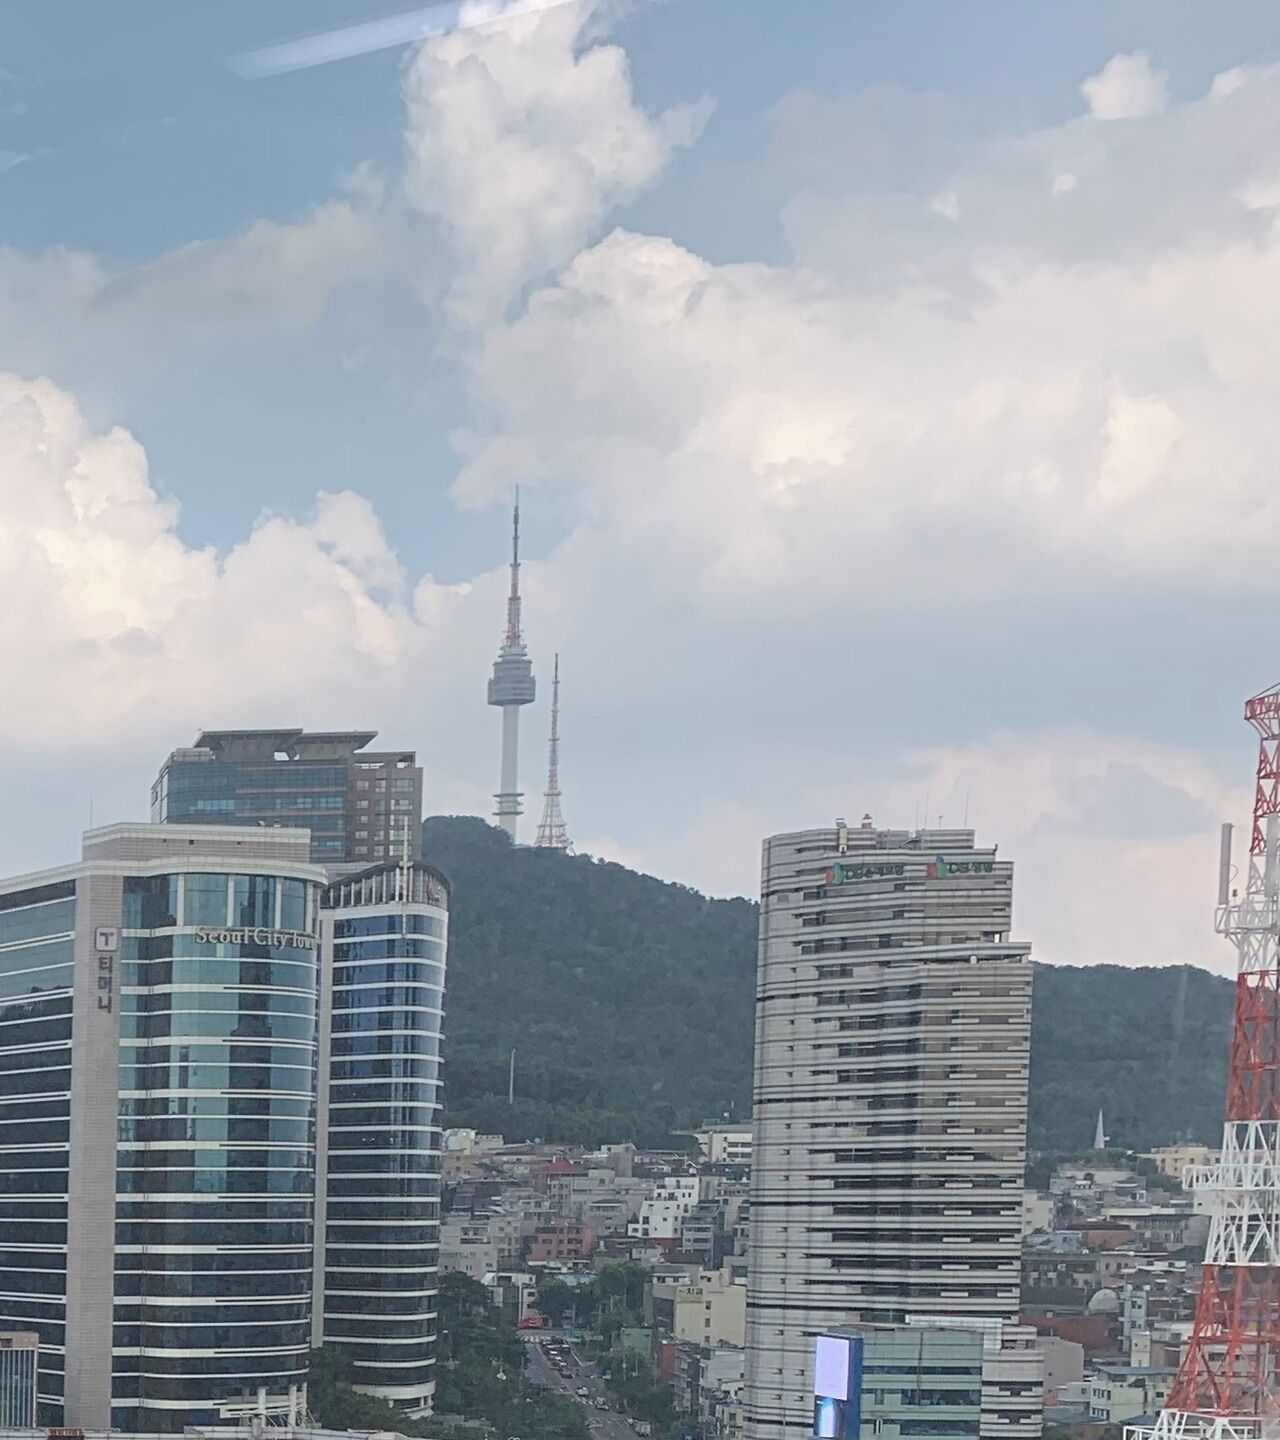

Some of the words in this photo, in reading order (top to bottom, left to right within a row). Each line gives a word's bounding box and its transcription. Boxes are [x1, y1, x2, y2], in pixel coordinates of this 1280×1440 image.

[196, 927, 249, 944] Seoul
[254, 928, 287, 949] City
[97, 955, 113, 1014] 티머니
